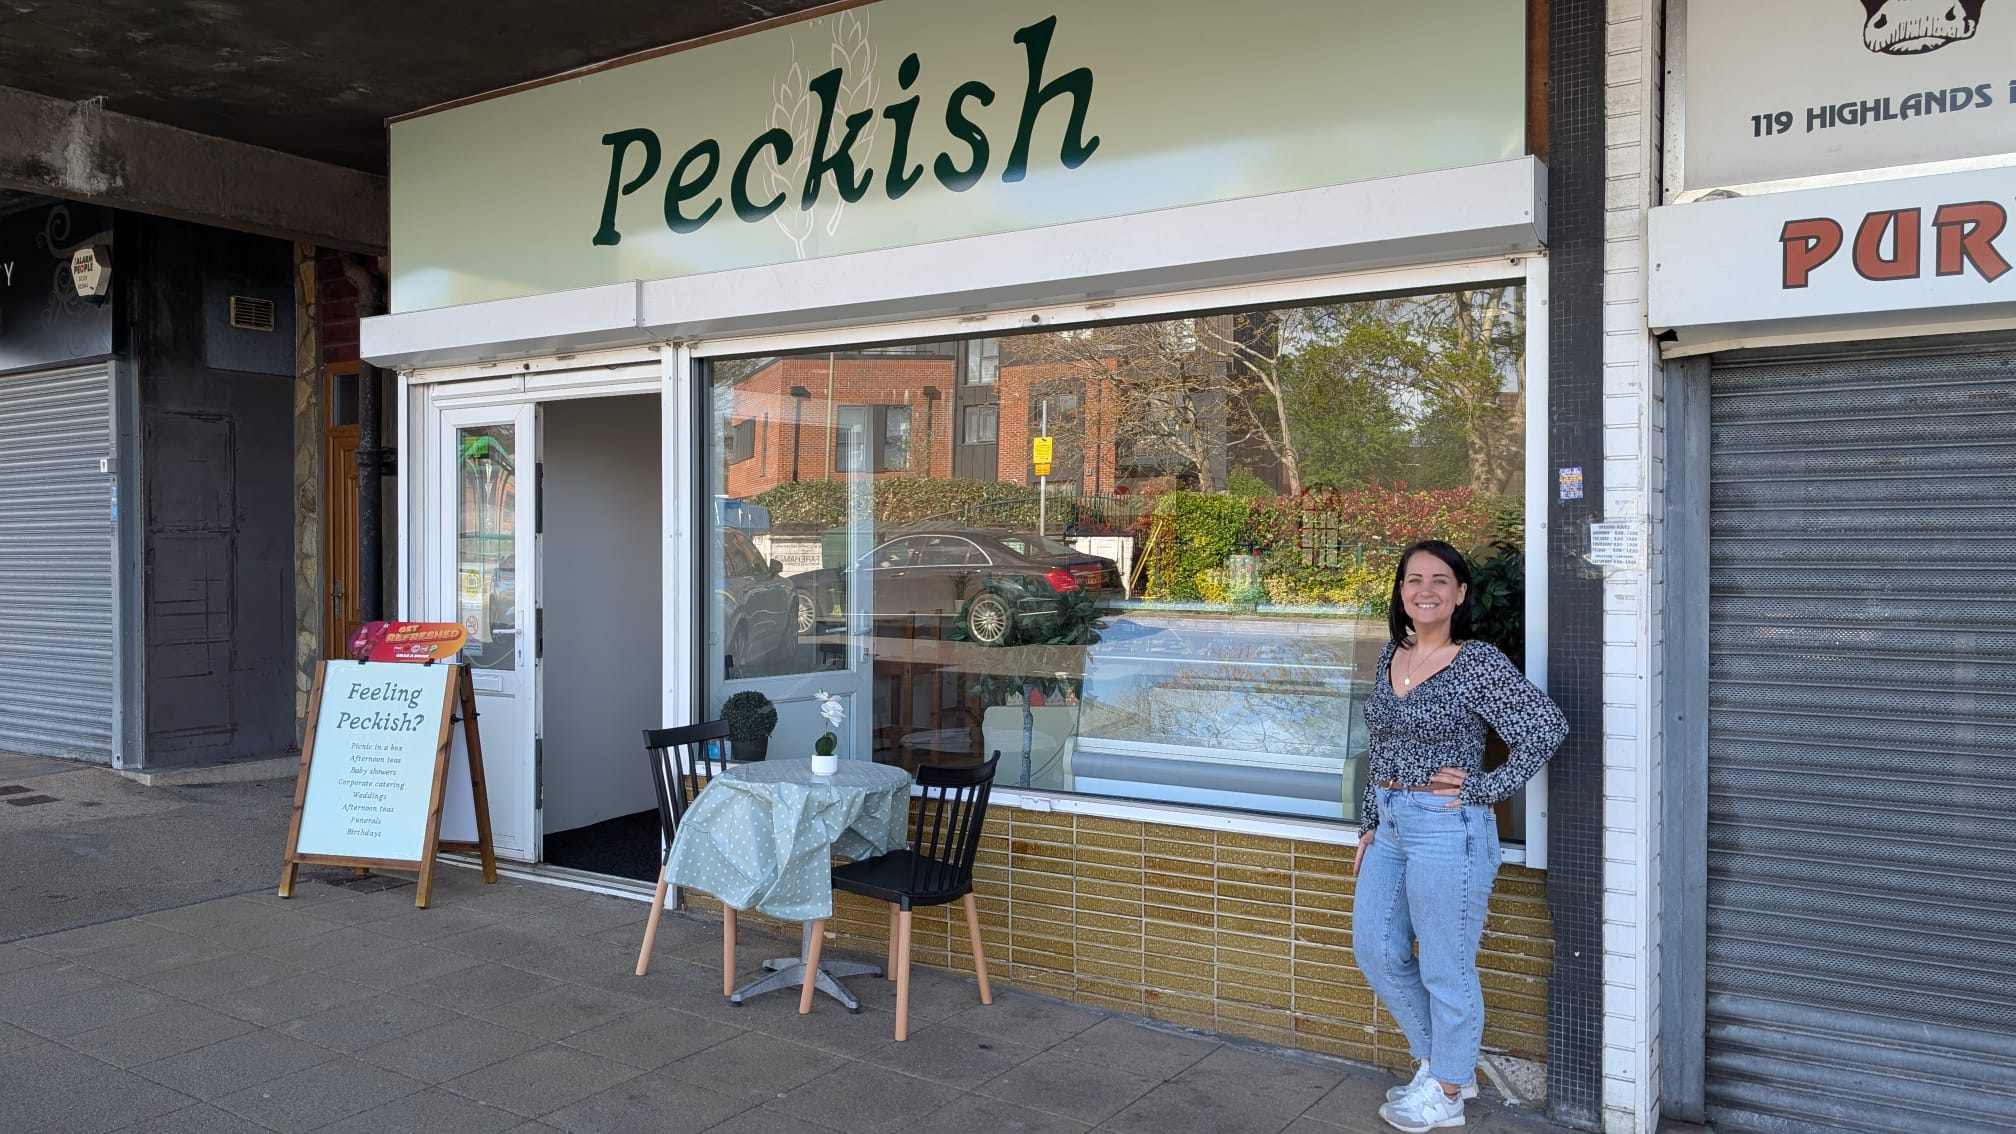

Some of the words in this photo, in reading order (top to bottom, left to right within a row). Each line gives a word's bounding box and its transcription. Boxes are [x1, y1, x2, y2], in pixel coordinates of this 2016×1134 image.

[1750, 111, 1793, 137] 119
[1806, 83, 1993, 133] HIGHLANDS
[593, 15, 1100, 246] Peckish
[1778, 198, 2016, 290] PUR
[0, 260, 15, 287] Y
[74, 262, 94, 275] PEOPLE
[398, 624, 420, 633] GET
[386, 630, 461, 643] REFRESHED
[346, 681, 423, 709] Feeling
[336, 711, 425, 732] Peckish?
[351, 742, 373, 750] Picnic
[374, 743, 382, 751] in
[390, 743, 404, 752] box
[349, 754, 385, 763] Afternoon
[386, 756, 401, 764] teas
[350, 766, 367, 775] Baby
[369, 767, 397, 776] showers
[338, 778, 373, 787] Corporate
[374, 780, 405, 791] catering
[353, 791, 387, 802] Weddings
[341, 803, 377, 812] Afternoon
[350, 816, 382, 825] Funerals
[346, 827, 382, 838] Birthdays
